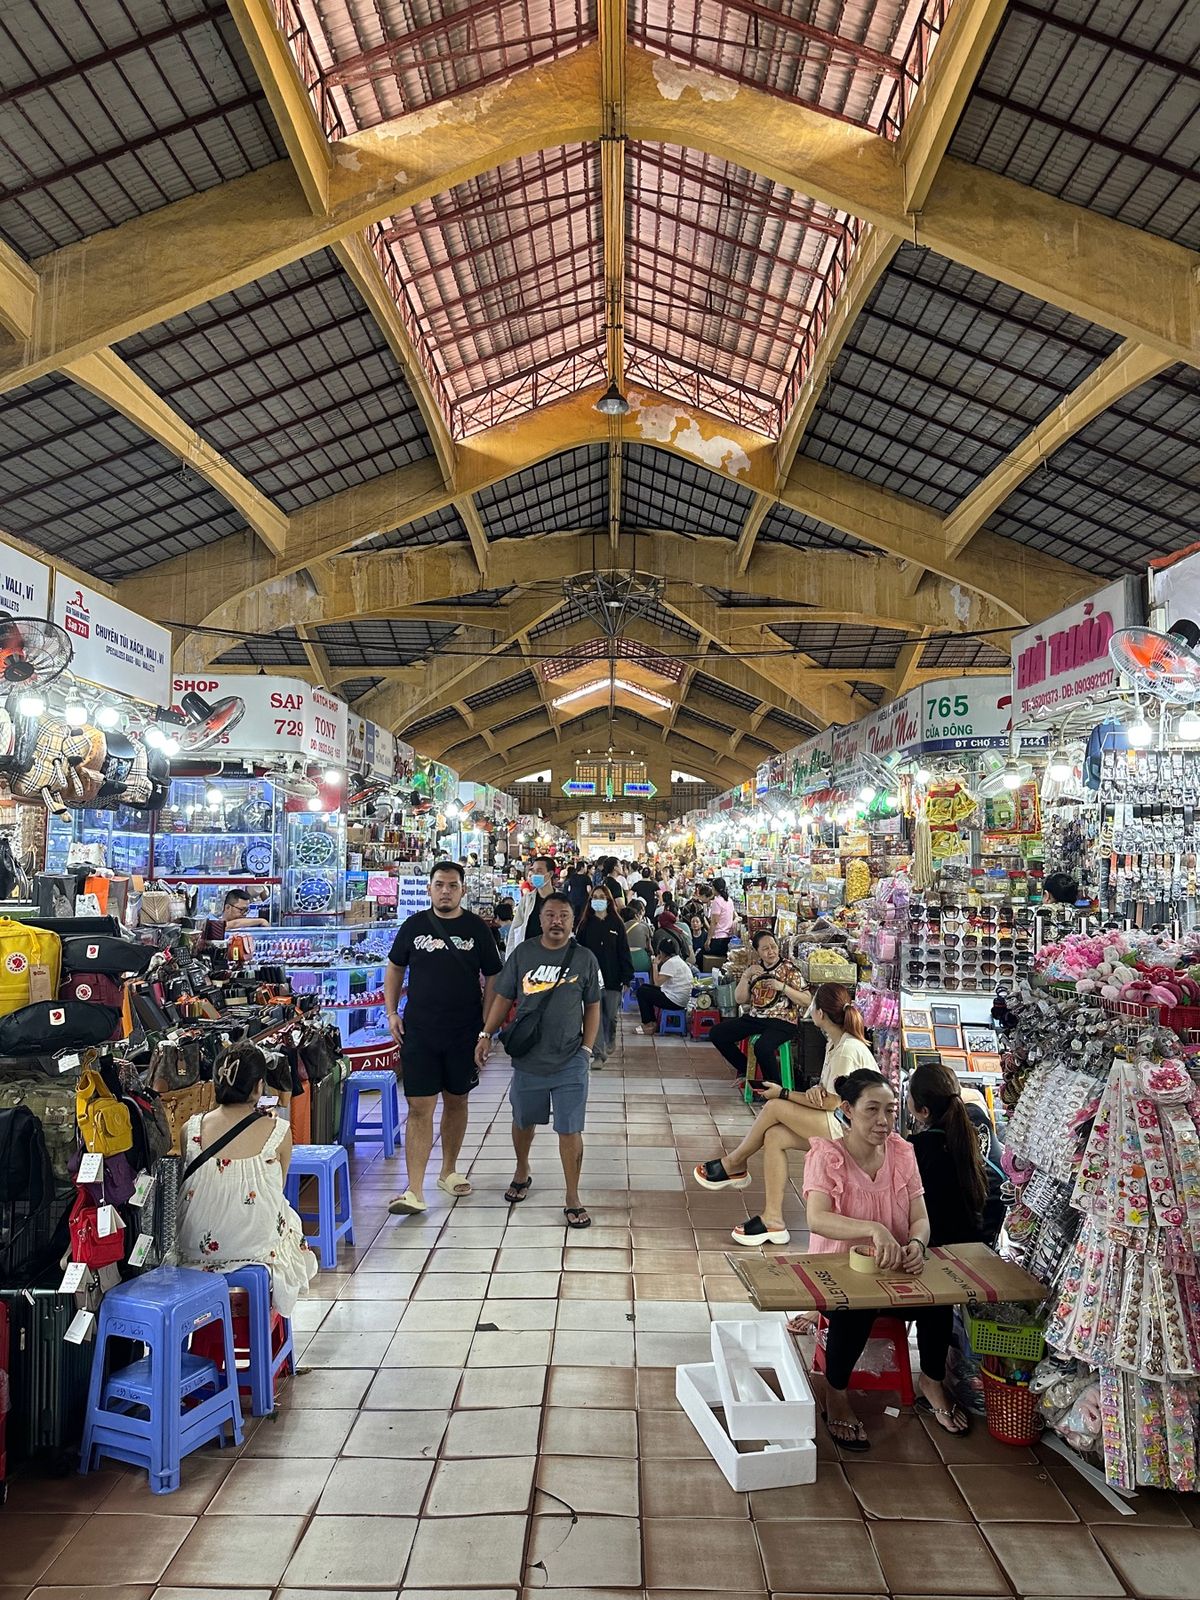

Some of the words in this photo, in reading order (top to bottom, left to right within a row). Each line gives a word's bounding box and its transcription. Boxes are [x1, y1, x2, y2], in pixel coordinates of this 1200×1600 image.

[1048, 602, 1114, 676] THẢO
[173, 680, 219, 692] SHOP
[270, 692, 304, 712] SẠP
[927, 695, 969, 719] 765
[274, 719, 304, 736] 729
[315, 716, 337, 740] TONY
[894, 710, 918, 748] Mai
[926, 724, 940, 739] CỬA
[942, 722, 973, 737] ĐÔNG
[955, 739, 967, 748] ĐT
[970, 738, 990, 747] CHỢ
